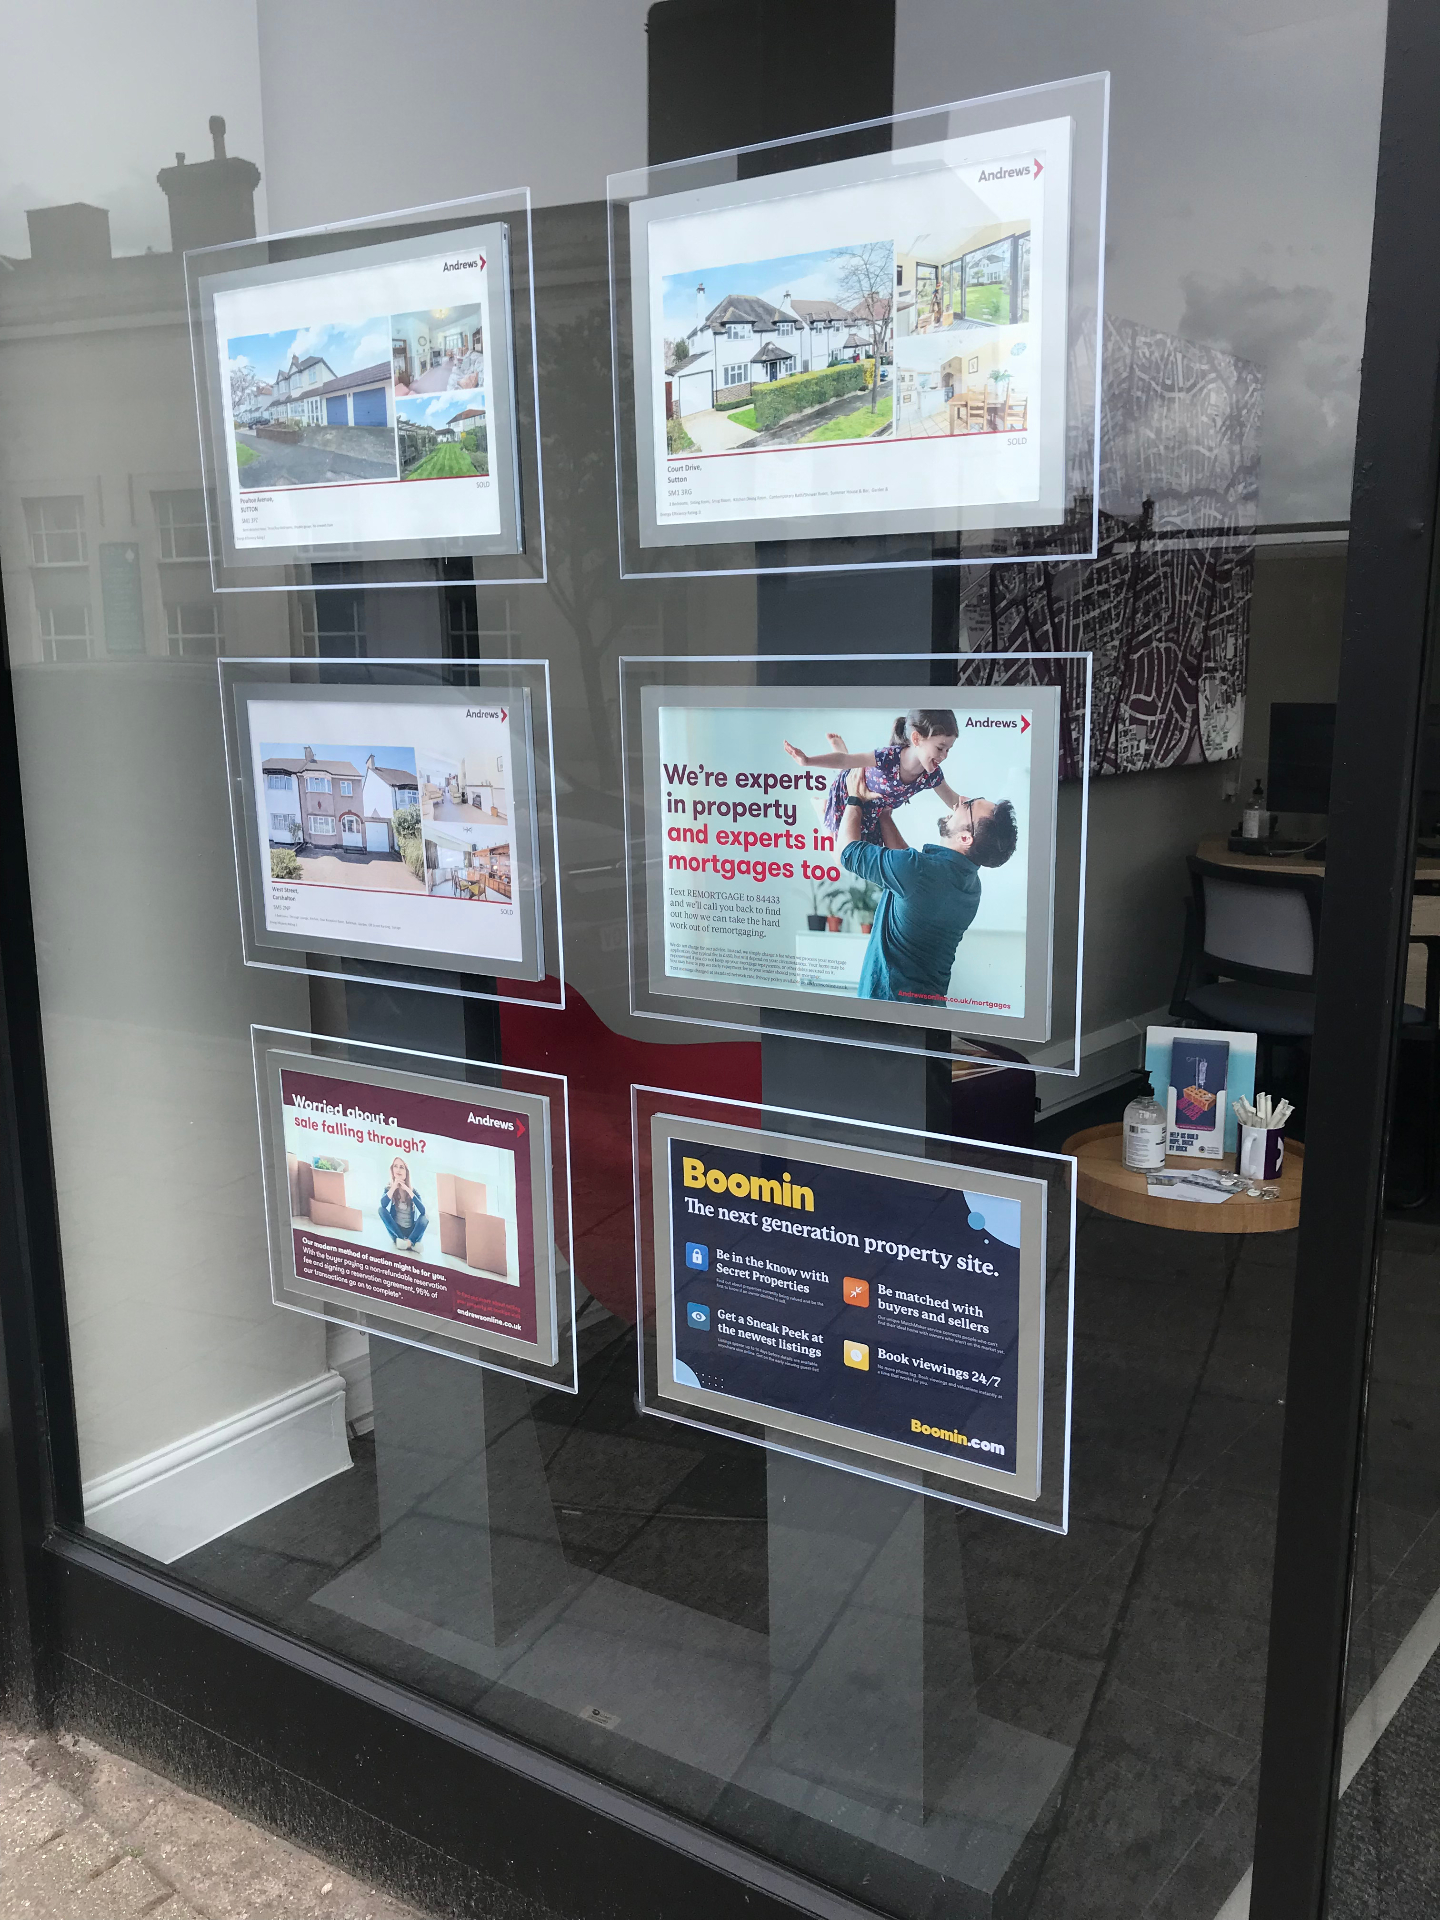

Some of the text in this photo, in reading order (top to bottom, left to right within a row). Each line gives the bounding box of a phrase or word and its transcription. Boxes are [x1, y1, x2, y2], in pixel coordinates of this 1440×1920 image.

[978, 166, 1031, 183] Andrews
[443, 260, 478, 273] Andrews
[1007, 438, 1027, 446] SOLD
[668, 476, 688, 484] Sutton
[466, 709, 499, 719] Andrews
[965, 717, 1018, 728] Andrews
[663, 764, 827, 795] We’re experts
[667, 792, 797, 826] in property
[668, 824, 834, 852] and experts in
[668, 854, 841, 882] mortgages too
[669, 888, 685, 896] Text
[687, 889, 744, 901] REMORTGAGE
[756, 895, 780, 904] 84433
[703, 903, 718, 911] call
[720, 904, 734, 912] you
[736, 904, 754, 914] back
[765, 907, 781, 916] find
[670, 910, 683, 918] out
[684, 911, 698, 920] how
[729, 916, 746, 924] take
[747, 917, 760, 926] the
[762, 918, 780, 927] hard
[670, 922, 688, 930] work
[702, 923, 710, 932] of
[712, 926, 766, 939] remortgaging.
[292, 1094, 398, 1127] Worried about a
[467, 1112, 514, 1131] Andrews
[295, 1117, 426, 1153] sale falling through?
[683, 1156, 815, 1212] Boomin
[685, 1197, 999, 1277] The next generation property site.
[302, 1236, 314, 1246] Our
[314, 1243, 338, 1252] modern
[338, 1248, 360, 1258] method
[369, 1256, 393, 1267] auction
[394, 1262, 412, 1272] might
[412, 1266, 420, 1274] be
[420, 1269, 431, 1277] for
[432, 1273, 447, 1281] you.
[303, 1246, 316, 1256] With
[316, 1250, 325, 1259] the
[326, 1253, 343, 1264] buyer
[344, 1259, 364, 1270] paying
[370, 1266, 413, 1283] non-refundable
[414, 1278, 448, 1291] reservation
[716, 1249, 829, 1283] Be in the know with
[303, 1256, 313, 1264] fee
[313, 1260, 324, 1268] and
[324, 1263, 345, 1275] signing
[351, 1271, 382, 1284] reservation
[416, 1287, 430, 1297] 95%
[314, 1269, 348, 1284] transactions
[716, 1263, 750, 1279] Secret
[752, 1271, 810, 1293] Properties
[878, 1284, 984, 1318] Be matched with
[457, 1308, 522, 1331] andrewsonline.co.uk
[718, 1309, 824, 1344] Get a Sneak Peek at
[878, 1299, 919, 1318] buyers
[922, 1311, 945, 1324] and
[948, 1317, 990, 1334] sellers
[718, 1324, 736, 1336] the
[738, 1329, 777, 1347] newest
[779, 1339, 822, 1358] listings
[878, 1348, 910, 1365] Book
[912, 1358, 970, 1380] viewings
[972, 1371, 1001, 1388] 24/7
[911, 1418, 1005, 1456] Boomin.com
